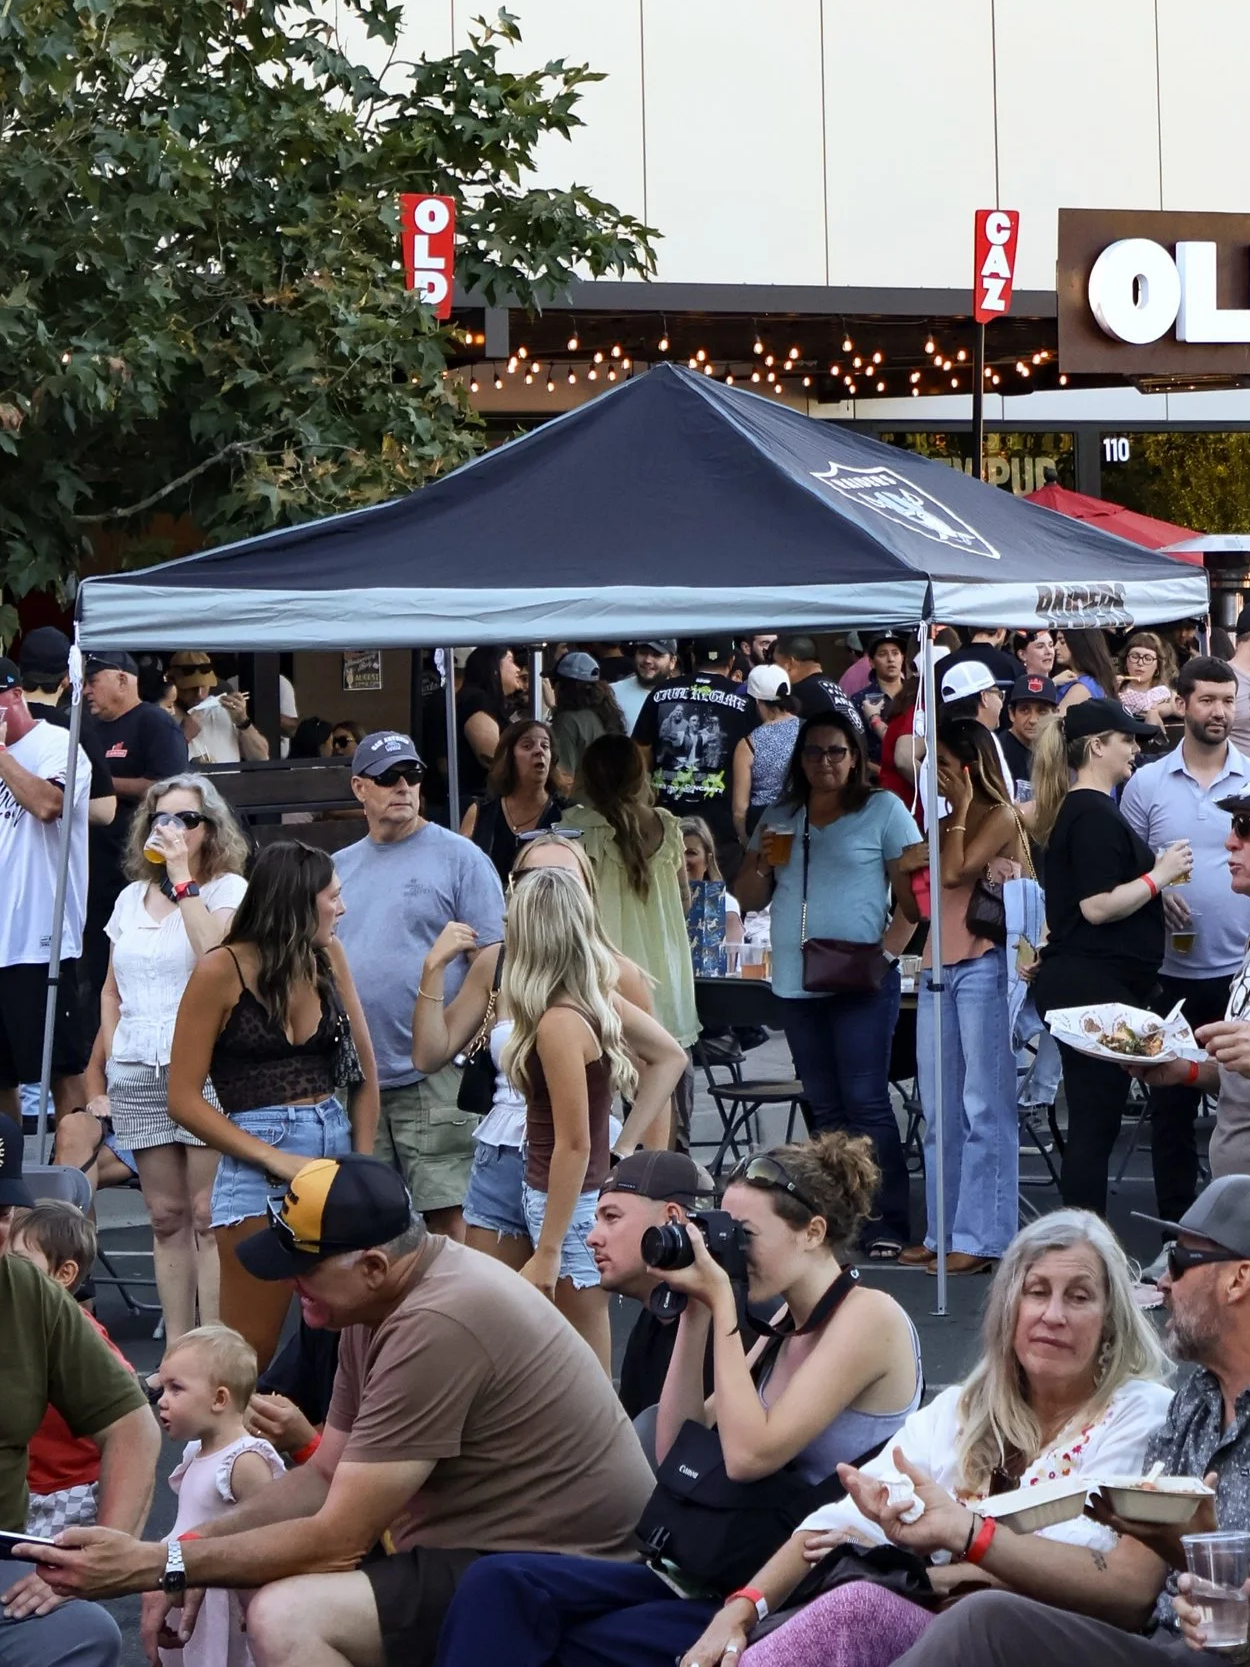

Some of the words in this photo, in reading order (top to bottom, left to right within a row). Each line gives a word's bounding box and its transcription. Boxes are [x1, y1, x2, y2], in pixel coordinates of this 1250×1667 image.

[414, 198, 449, 304] OLD
[980, 211, 1011, 311] CAZ
[1103, 438, 1130, 462] 110
[830, 474, 897, 490] RAIDERS
[678, 1464, 700, 1480] Canon
